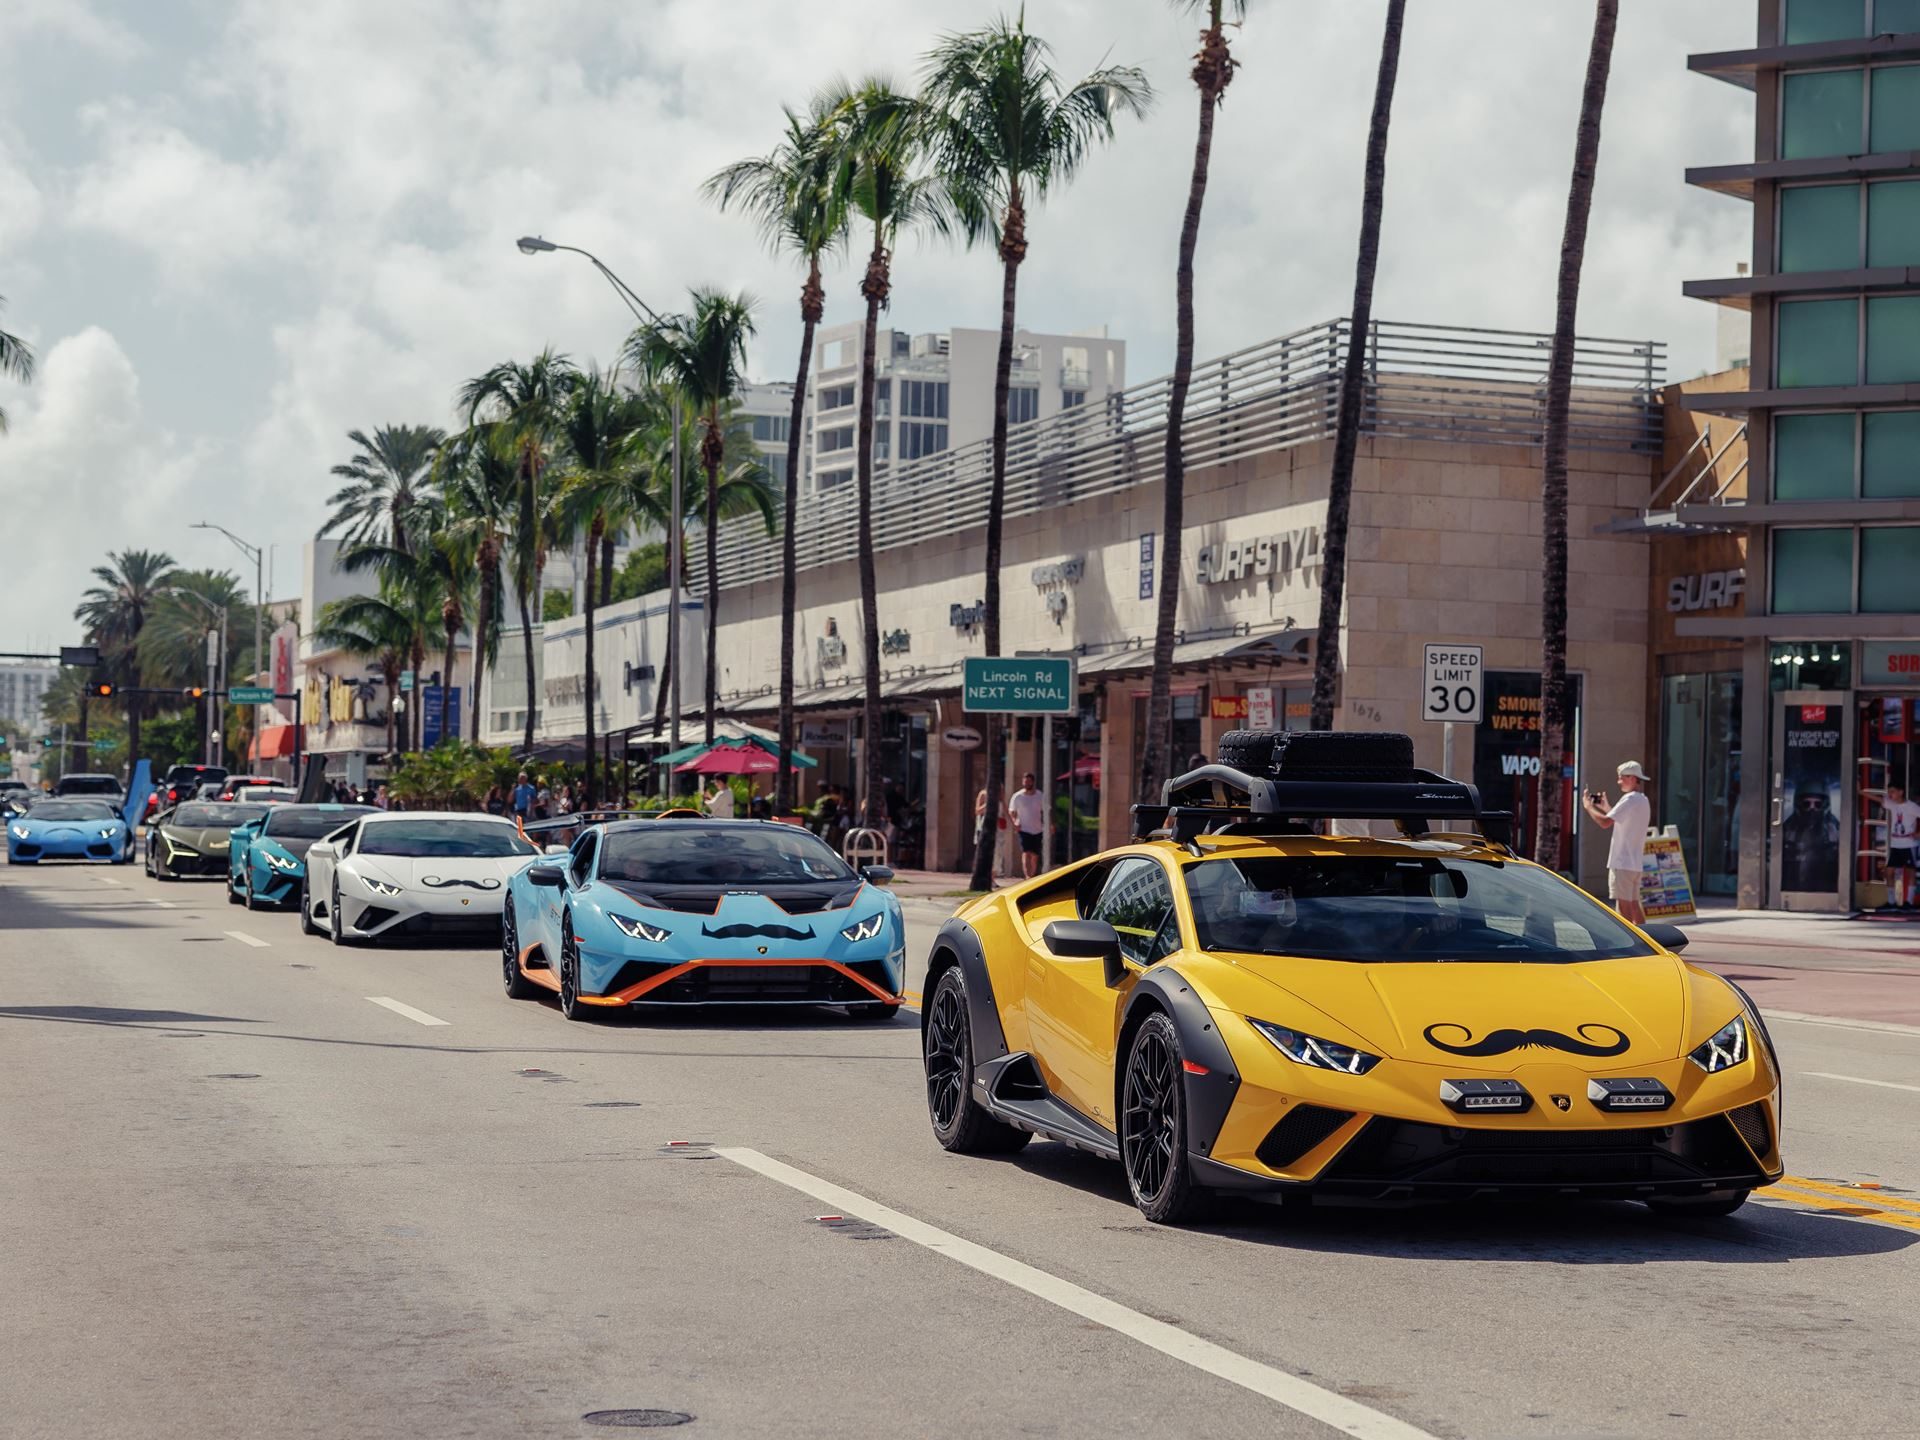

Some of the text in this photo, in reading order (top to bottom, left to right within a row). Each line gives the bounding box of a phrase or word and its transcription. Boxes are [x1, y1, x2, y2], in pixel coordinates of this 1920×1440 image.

[1666, 568, 1746, 612] SURF
[1429, 653, 1478, 665] SPEED
[983, 671, 1052, 683] Lincoln Rd
[1434, 669, 1472, 681] LIMIT
[231, 691, 260, 700] Lincoln
[968, 687, 1066, 699] NEXT SIGNAL
[1429, 686, 1476, 713] 30
[1352, 701, 1382, 723] 1676
[1823, 730, 1839, 739] WITH
